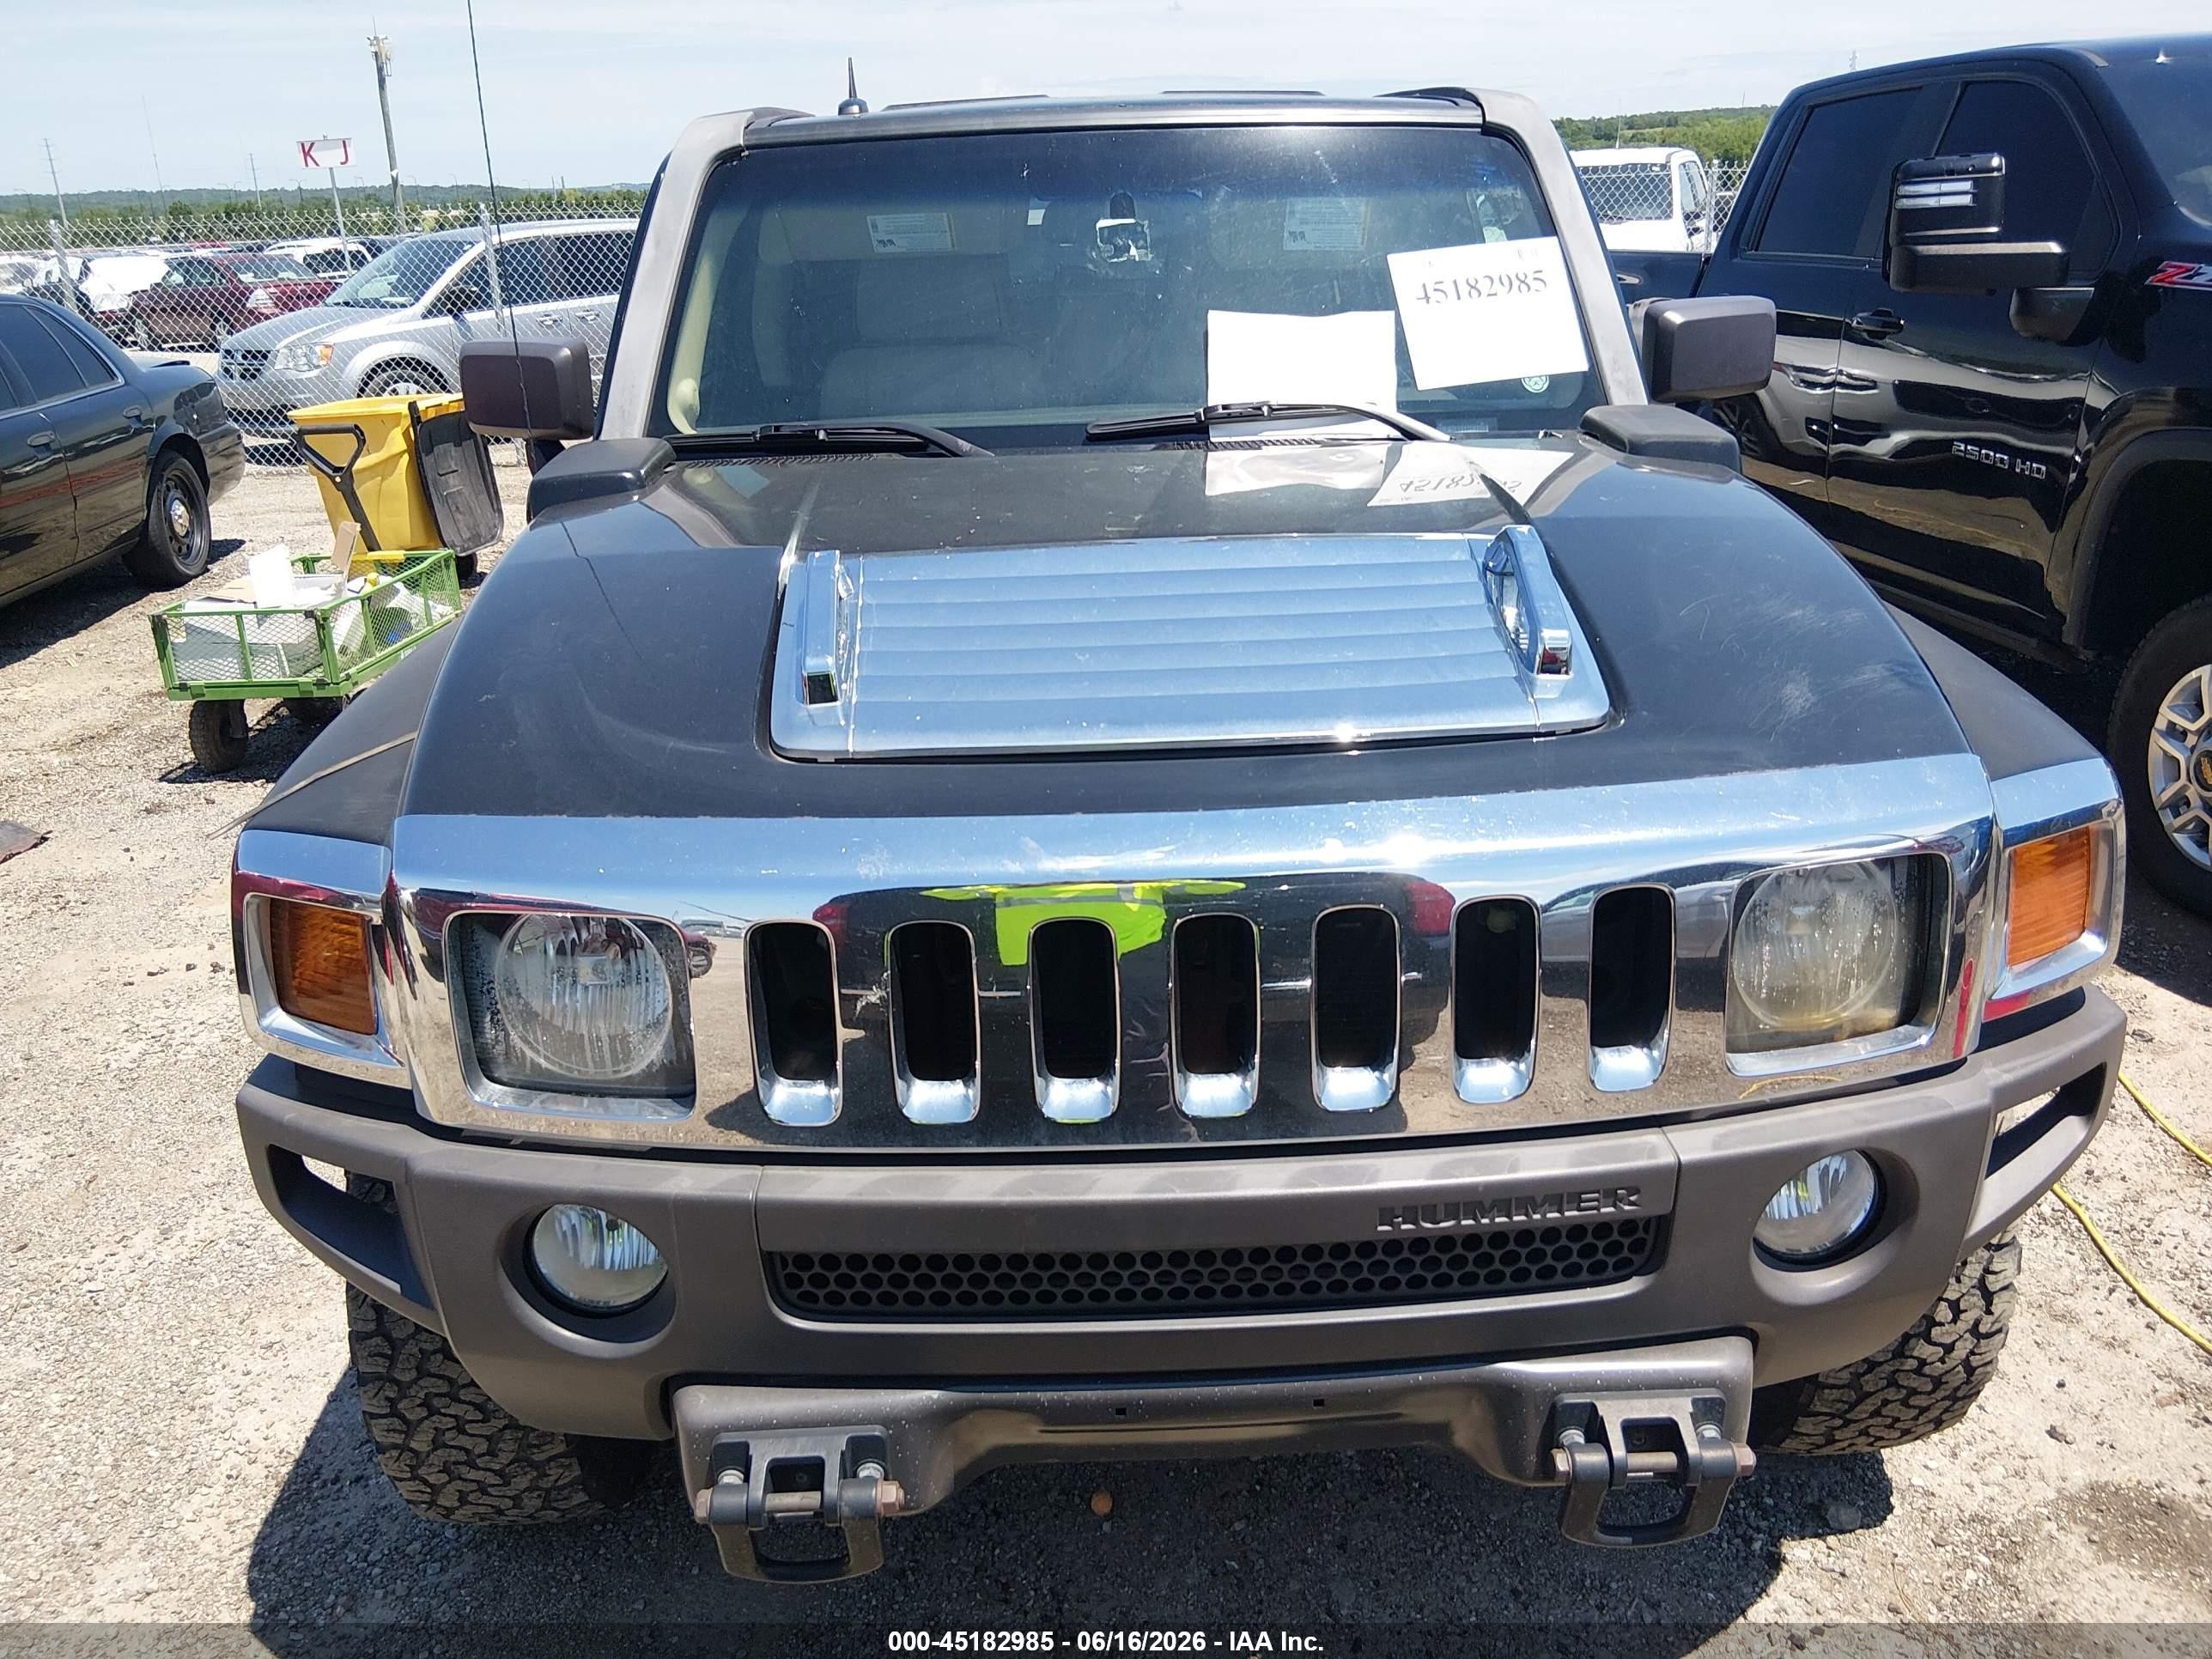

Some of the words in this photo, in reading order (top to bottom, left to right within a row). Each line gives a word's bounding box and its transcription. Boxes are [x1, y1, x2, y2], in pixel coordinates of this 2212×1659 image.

[301, 142, 319, 167] K
[340, 140, 349, 165] J
[1417, 270, 1547, 304] 45182985
[1952, 441, 2008, 469] 2500
[2015, 459, 2046, 479] HD
[1376, 1187, 1641, 1231] HUMMER
